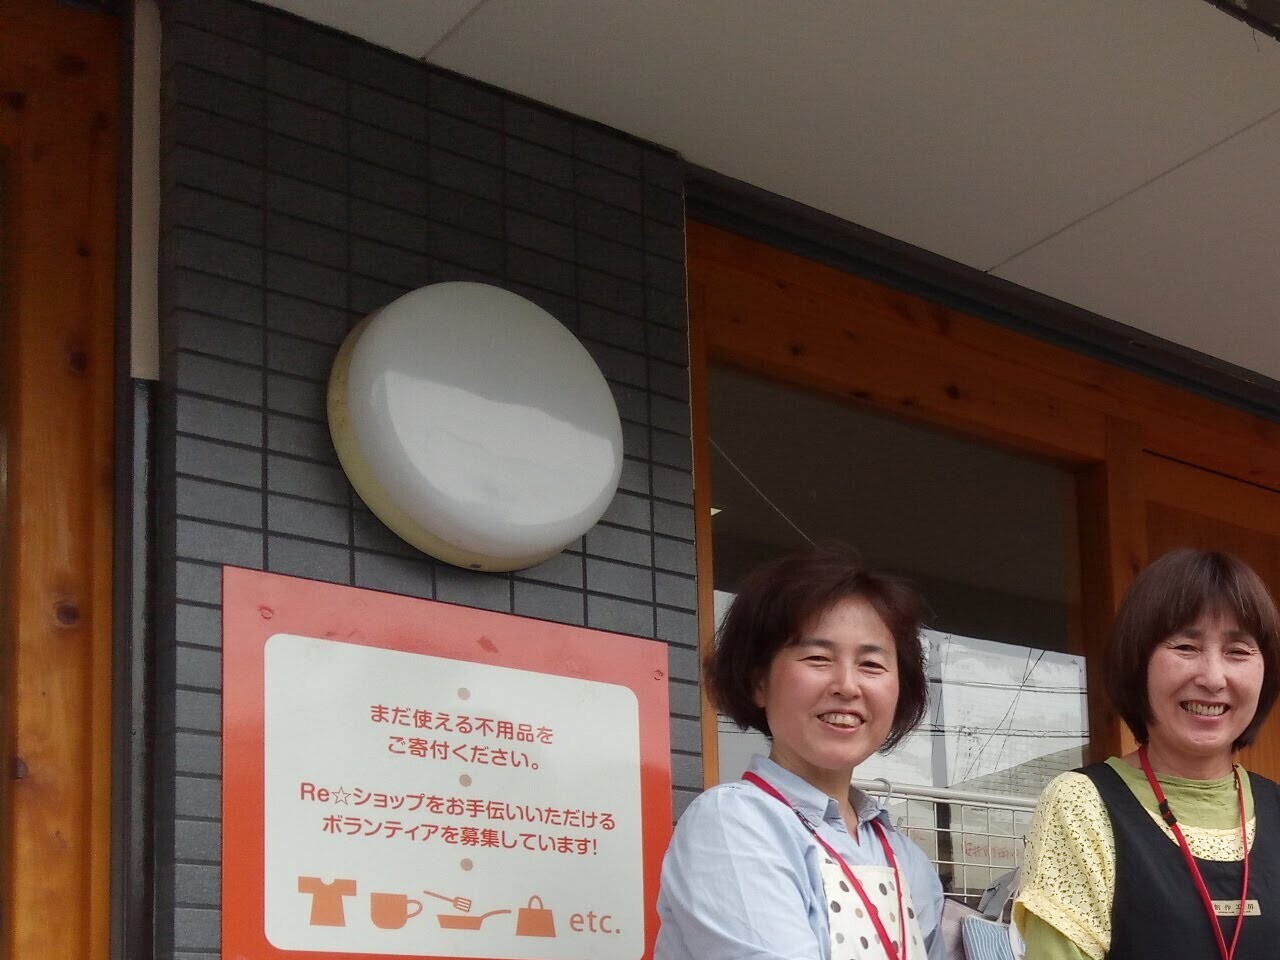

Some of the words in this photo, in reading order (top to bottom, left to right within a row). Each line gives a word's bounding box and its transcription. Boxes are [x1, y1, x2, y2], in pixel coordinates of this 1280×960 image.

[370, 704, 554, 745] まだ使える不用品を
[387, 735, 540, 770] ご寄付ください。
[322, 814, 598, 856] ボランティアを募集しています!
[569, 910, 622, 935] etc.
